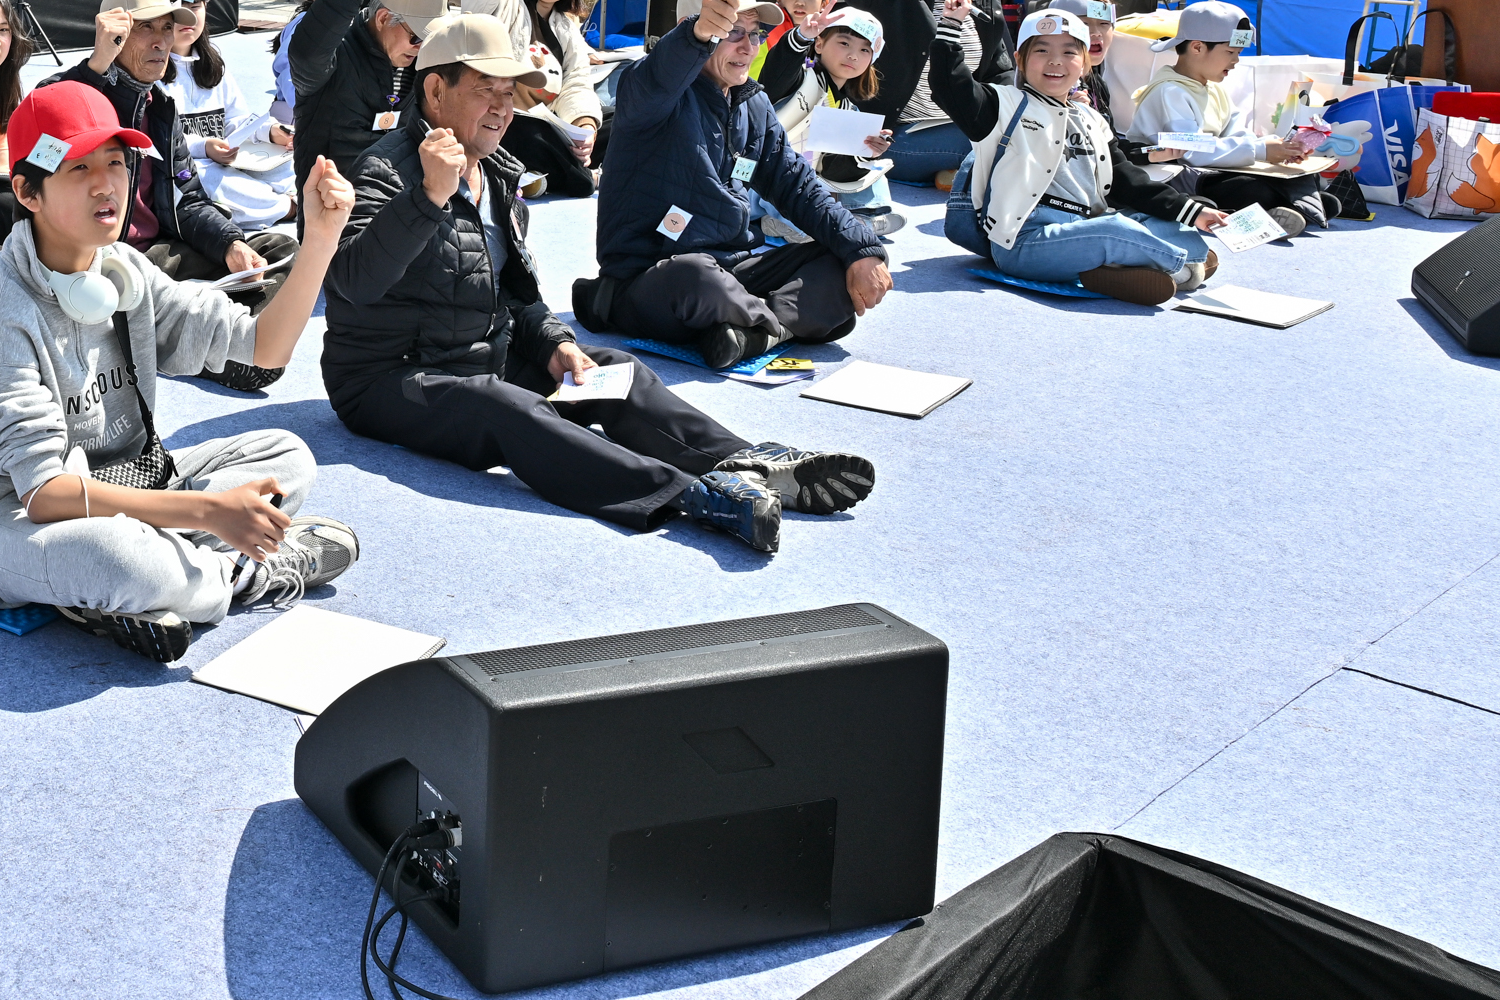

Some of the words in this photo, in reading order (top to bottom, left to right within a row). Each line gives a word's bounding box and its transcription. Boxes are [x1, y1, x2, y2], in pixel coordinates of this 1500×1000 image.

[1041, 22, 1052, 30] 27
[1384, 119, 1410, 187] VISA
[108, 414, 132, 440] LIFE
